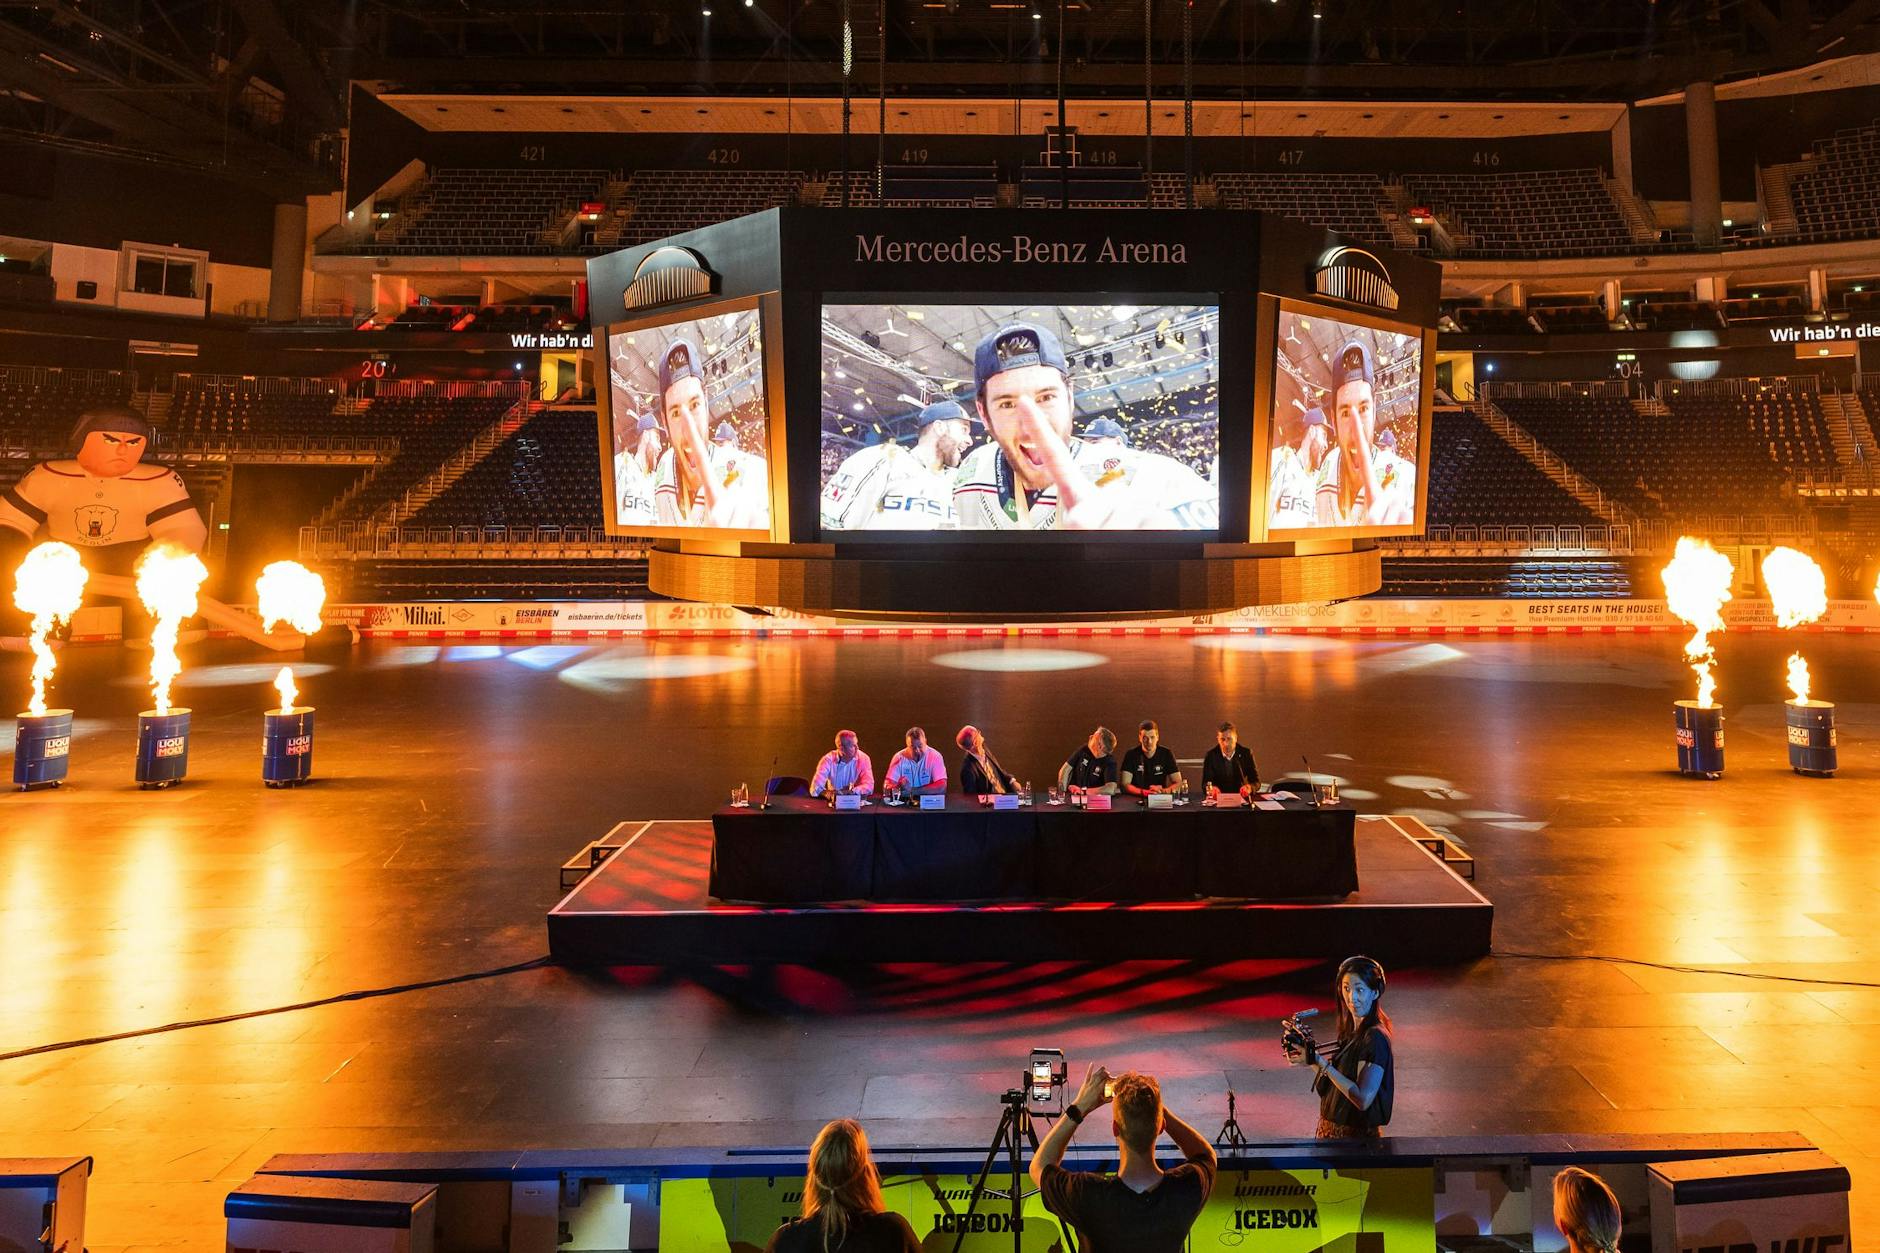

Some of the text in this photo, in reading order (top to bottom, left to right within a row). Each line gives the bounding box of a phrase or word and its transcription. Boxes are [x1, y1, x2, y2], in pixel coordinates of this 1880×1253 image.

[520, 146, 545, 161] 421
[708, 149, 740, 163] 420
[901, 149, 928, 163] 419
[1090, 151, 1116, 165] 418
[1279, 151, 1304, 165] 417
[1472, 152, 1500, 166] 416
[855, 235, 1187, 263] Mercedes-Benz Arena
[1770, 328, 1801, 342] Wir
[1855, 323, 1880, 338] die
[511, 334, 537, 347] Wir
[404, 606, 446, 625] Mihai.
[516, 609, 560, 617] EISBÄREN
[688, 606, 734, 620] LOTTO
[1528, 604, 1663, 614] BEST SEATS IN THE HOUSE!
[568, 612, 643, 621] eisbaeren.de/tickets
[159, 737, 184, 748] LIQUI
[158, 745, 183, 757] MOLY
[1234, 1184, 1317, 1197] WARRIOR
[1234, 1208, 1318, 1229] ICEBOX
